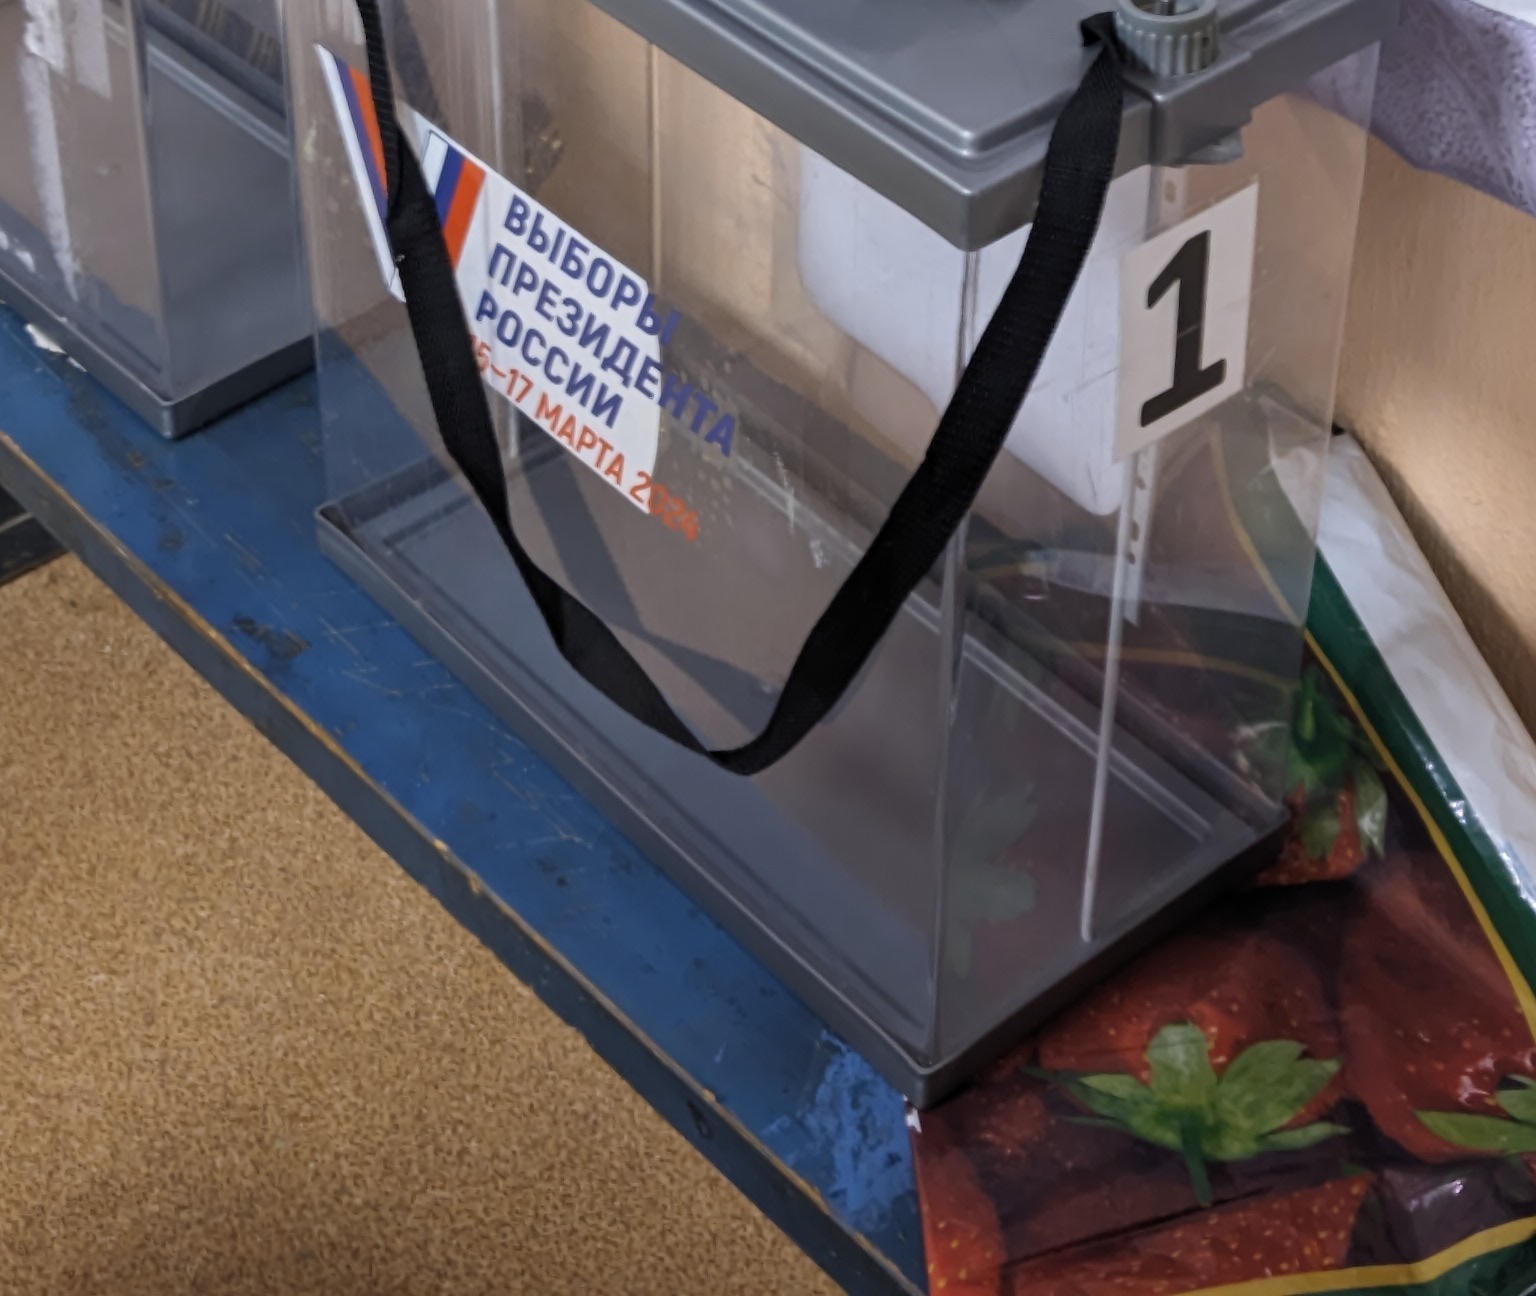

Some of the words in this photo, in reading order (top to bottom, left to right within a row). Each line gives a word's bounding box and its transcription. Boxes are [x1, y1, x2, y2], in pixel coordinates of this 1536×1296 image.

[503, 193, 682, 347] ВЫБОРЫ
[1139, 229, 1227, 429] 1
[475, 288, 624, 430] РОССИИ
[487, 241, 737, 457] ПРЕЗИДЕНТА
[535, 392, 626, 487] МАРТА
